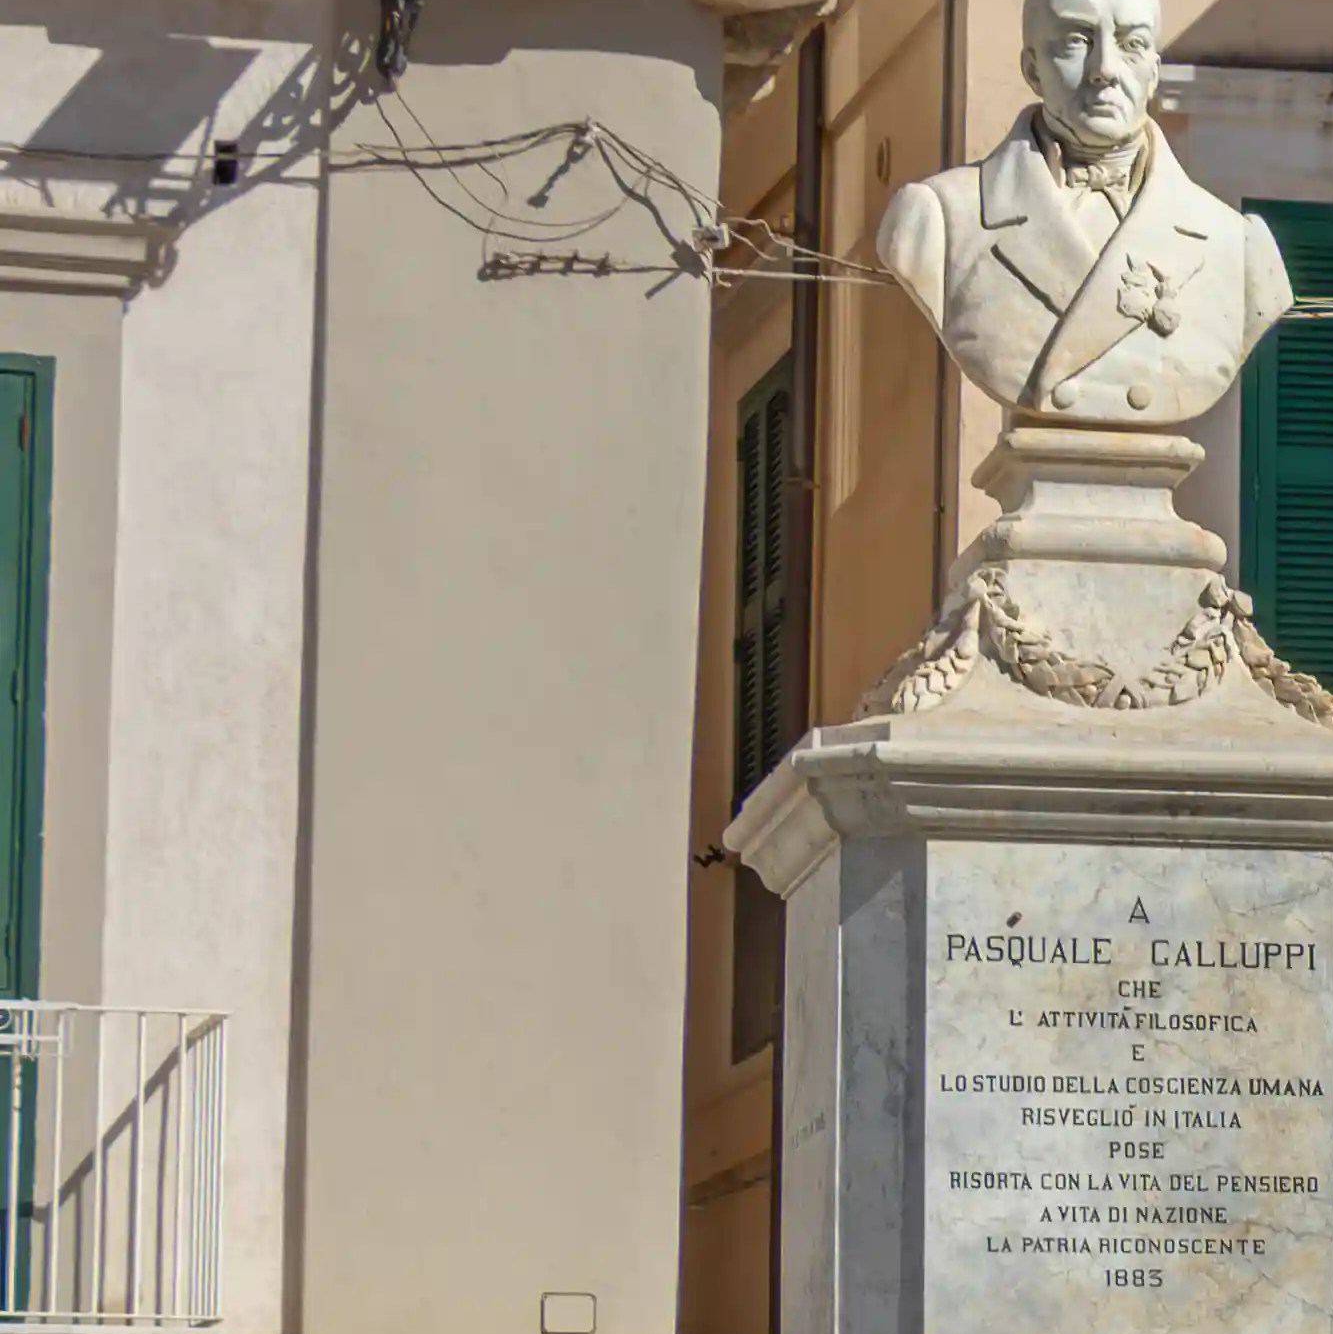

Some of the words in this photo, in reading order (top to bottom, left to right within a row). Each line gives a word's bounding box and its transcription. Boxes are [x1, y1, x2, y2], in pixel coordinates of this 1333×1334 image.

[1128, 896, 1150, 924] A
[946, 934, 1112, 968] PASQUALE
[1151, 939, 1316, 971] GALLUPPI
[1117, 980, 1162, 999] CHE
[1134, 1012, 1258, 1033] FILOSOFICA
[1131, 1044, 1145, 1062] E
[940, 1073, 967, 1092] LO
[972, 1074, 1046, 1093] STUDIO
[1052, 1075, 1120, 1095] DELLA
[1125, 1077, 1242, 1096] COSCIENZA
[1249, 1078, 1325, 1097] UMANA
[1144, 1109, 1166, 1128] IN
[1174, 1110, 1243, 1129] ITALIA
[1108, 1141, 1165, 1160] POSE
[949, 1170, 1033, 1190] RISORTA
[1040, 1173, 1080, 1191] CON
[1087, 1173, 1113, 1191] LA
[1118, 1173, 1162, 1192] VITA
[1169, 1174, 1209, 1193] DEL
[1216, 1175, 1319, 1194] PENSIERO
[1039, 1206, 1053, 1223] A
[1057, 1206, 1101, 1224] VITA
[1108, 1206, 1128, 1224] DI
[1135, 1206, 1228, 1225] NAZIONE
[986, 1235, 1013, 1253] LA
[1021, 1237, 1092, 1255] PATRIA
[1098, 1237, 1266, 1256] RICONOSCENTE
[1104, 1269, 1164, 1288] 1883
